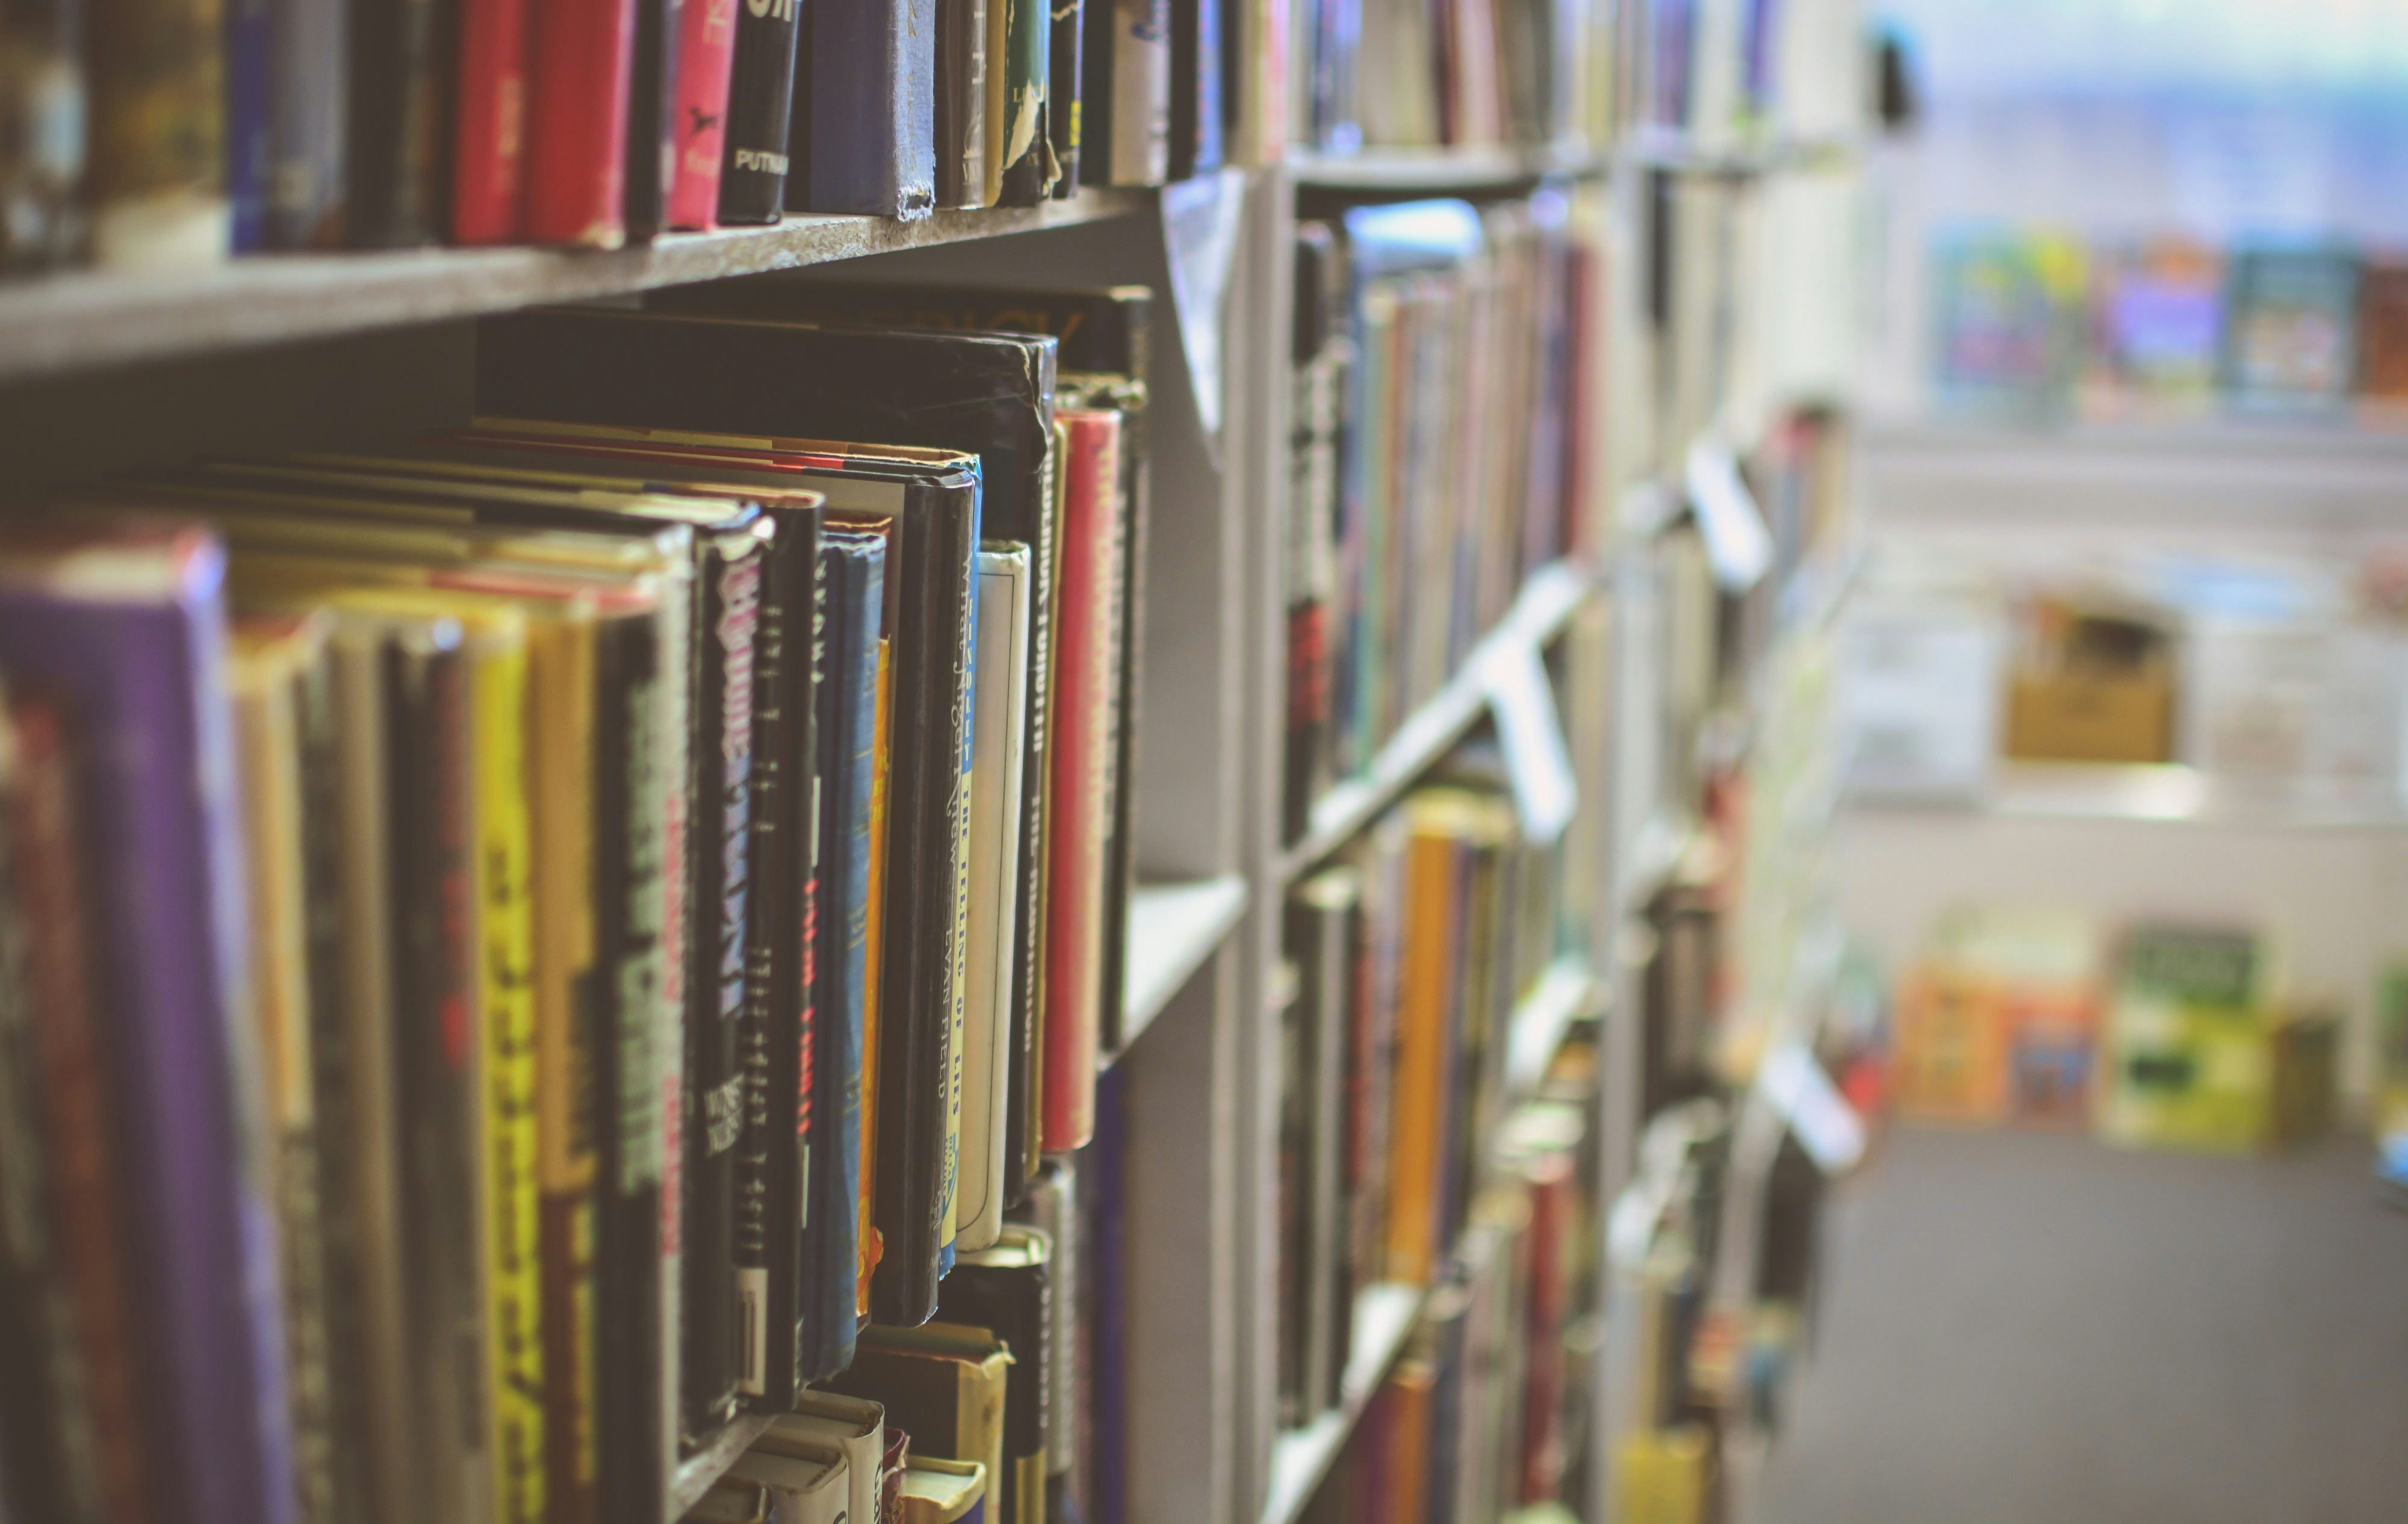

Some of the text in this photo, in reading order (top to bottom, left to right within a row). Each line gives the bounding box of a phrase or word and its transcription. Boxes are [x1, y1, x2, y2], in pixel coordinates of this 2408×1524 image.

[959, 552, 972, 650] What
[951, 661, 967, 754] Nigel
[958, 856, 967, 977] TELLING
[939, 929, 952, 1100] EVAN FIELD
[956, 997, 963, 1029] OF
